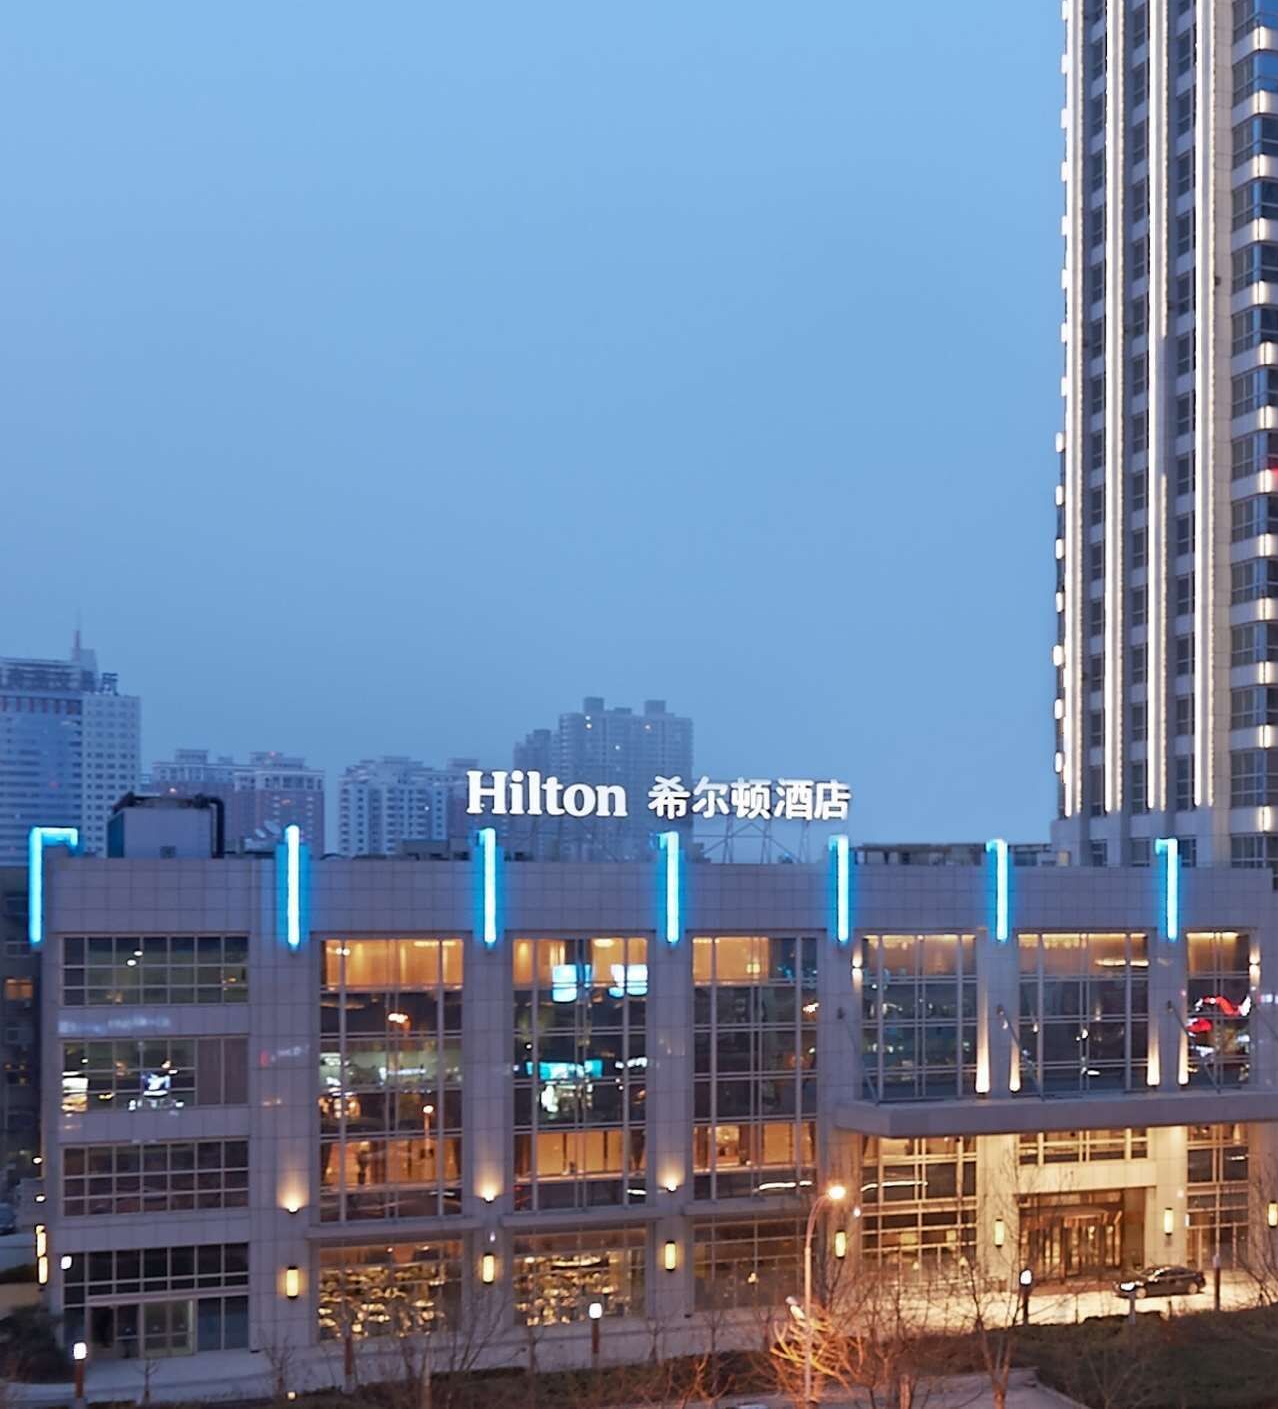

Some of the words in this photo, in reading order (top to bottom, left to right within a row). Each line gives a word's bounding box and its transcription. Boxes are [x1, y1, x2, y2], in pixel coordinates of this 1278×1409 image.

[466, 769, 628, 818] Hilton
[647, 775, 852, 821] 希尔顿酒店
